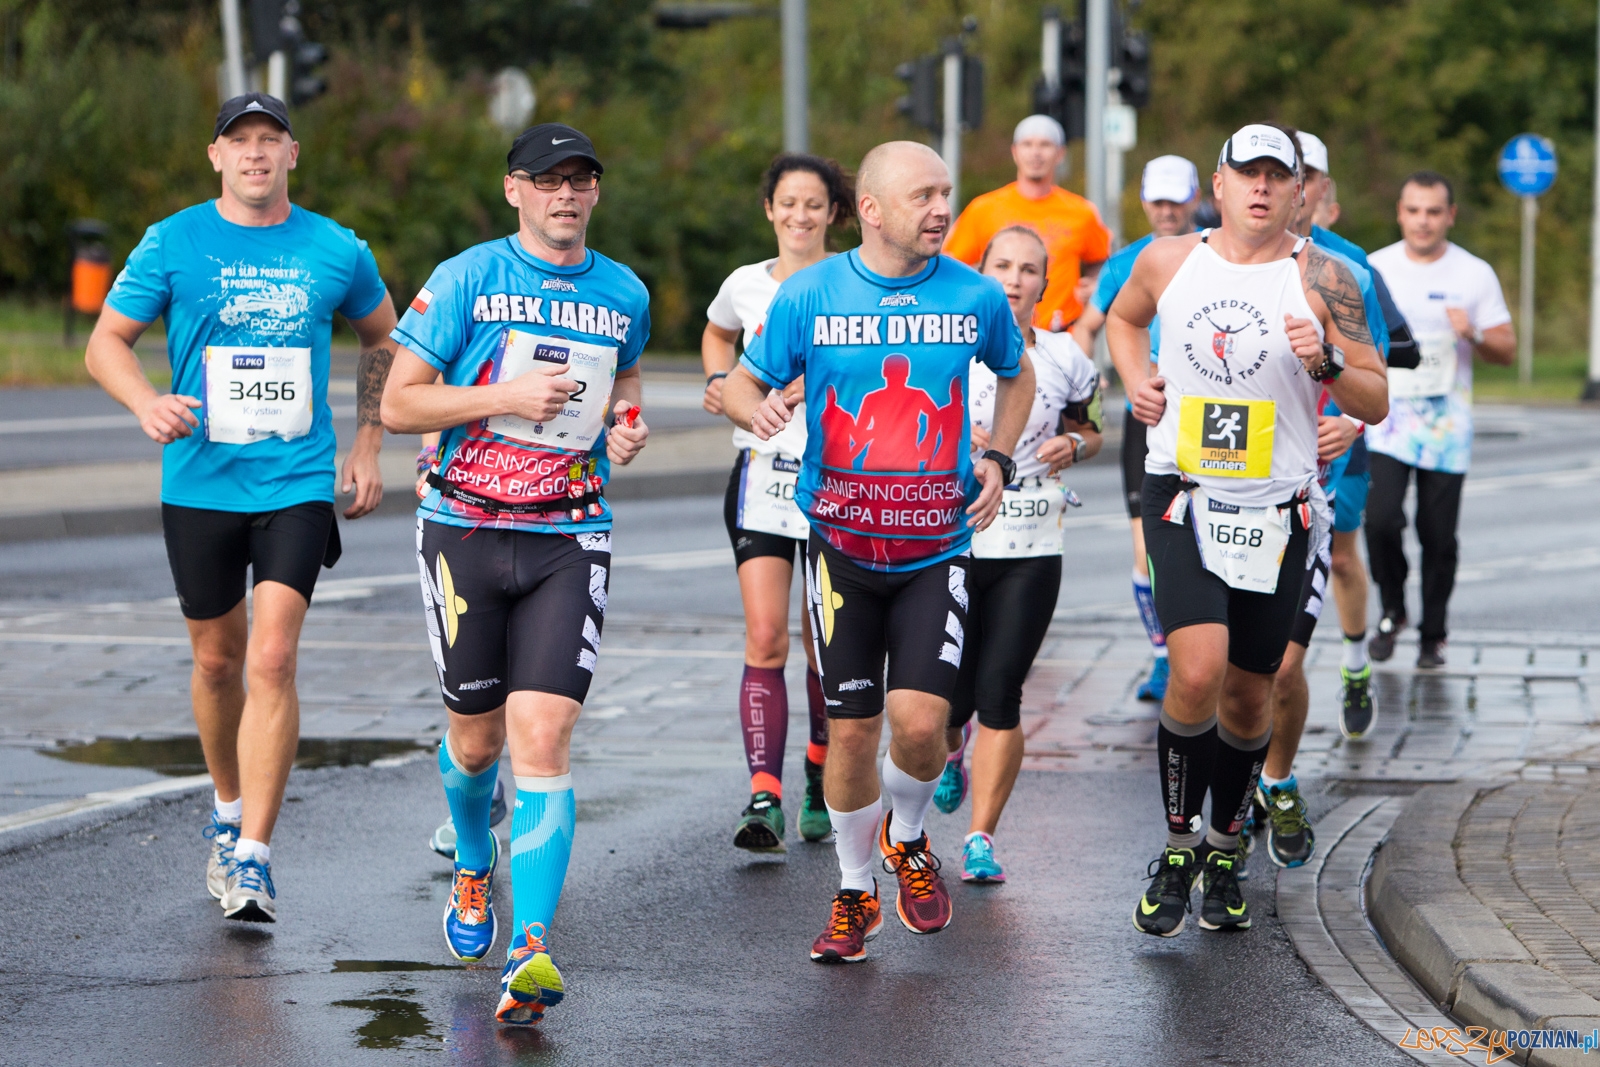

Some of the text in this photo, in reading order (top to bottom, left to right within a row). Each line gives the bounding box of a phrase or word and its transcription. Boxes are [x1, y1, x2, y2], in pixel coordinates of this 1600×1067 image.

[473, 293, 546, 324] AREK
[1186, 300, 1269, 336] POBIEDZISKA
[813, 314, 978, 345] AREK DYBIEC
[1184, 343, 1233, 385] Running
[1238, 350, 1269, 380] Team
[229, 381, 296, 401] 3456
[242, 406, 283, 417] Krystian
[1200, 459, 1246, 471] runners
[1210, 449, 1239, 460] night
[816, 498, 963, 527] GRUPA BIEGOWA
[997, 499, 1049, 518] 4530
[1208, 522, 1263, 548] 1668
